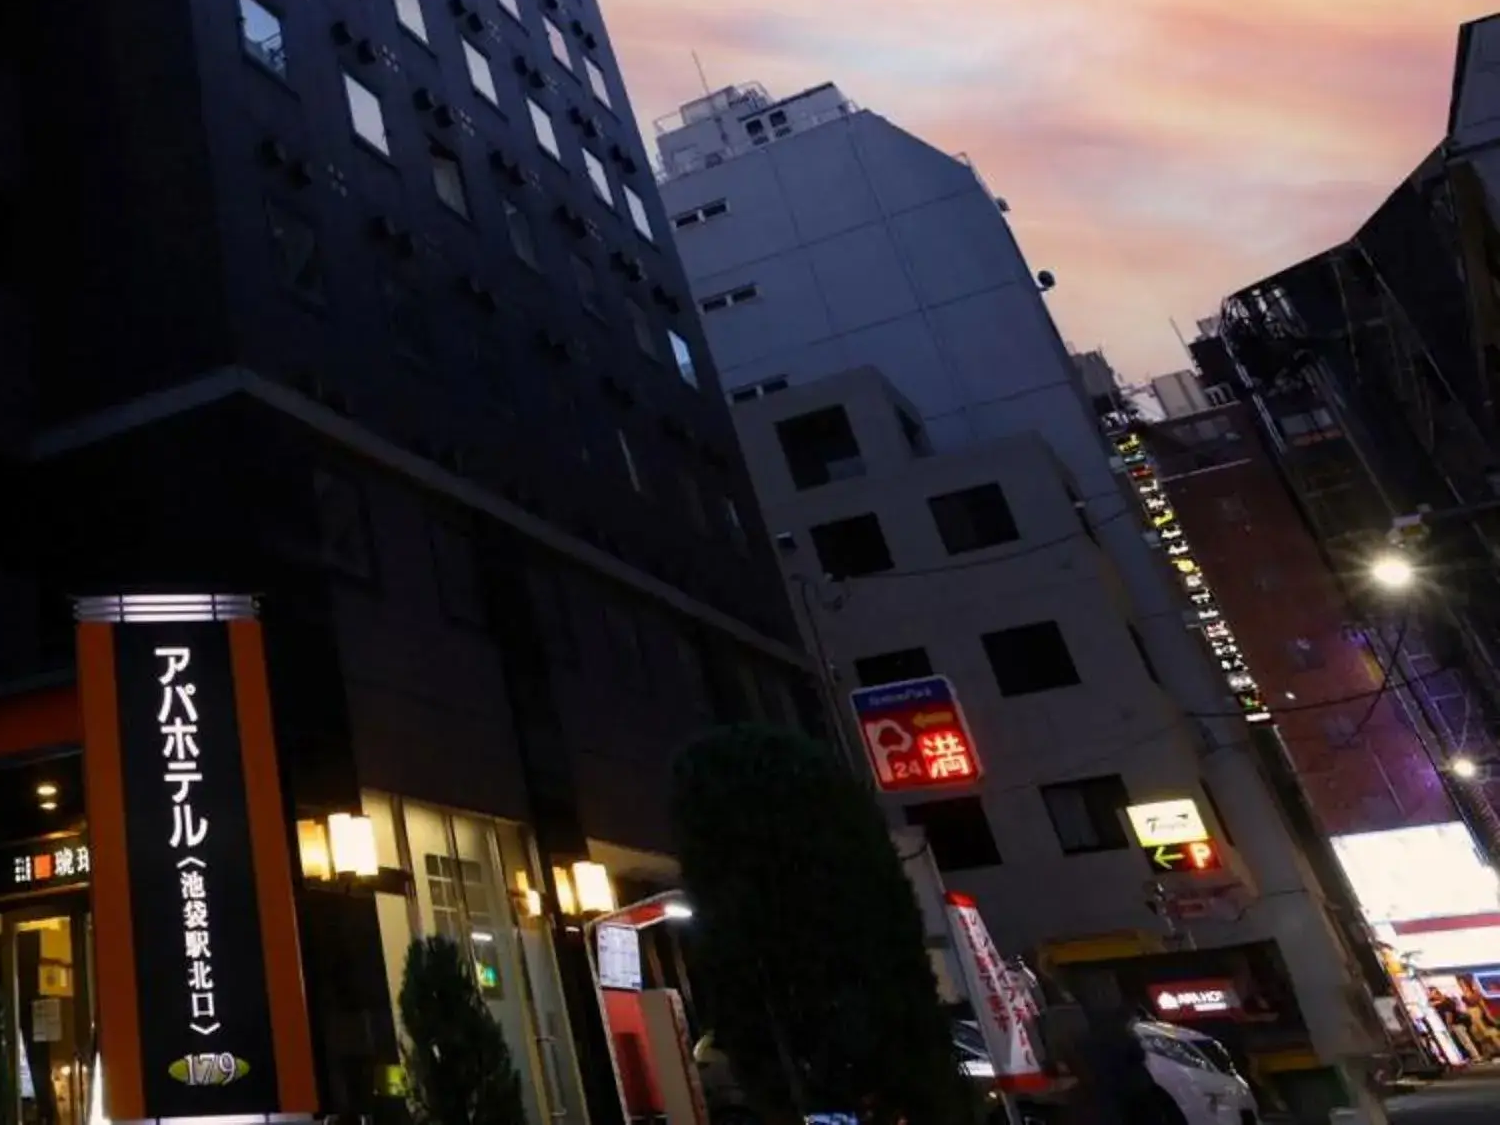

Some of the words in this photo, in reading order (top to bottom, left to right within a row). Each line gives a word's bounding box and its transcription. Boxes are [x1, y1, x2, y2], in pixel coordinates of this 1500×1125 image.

[894, 759, 921, 779] 24
[922, 730, 969, 779] 満
[1189, 841, 1212, 870] P
[184, 1052, 236, 1087] 179
